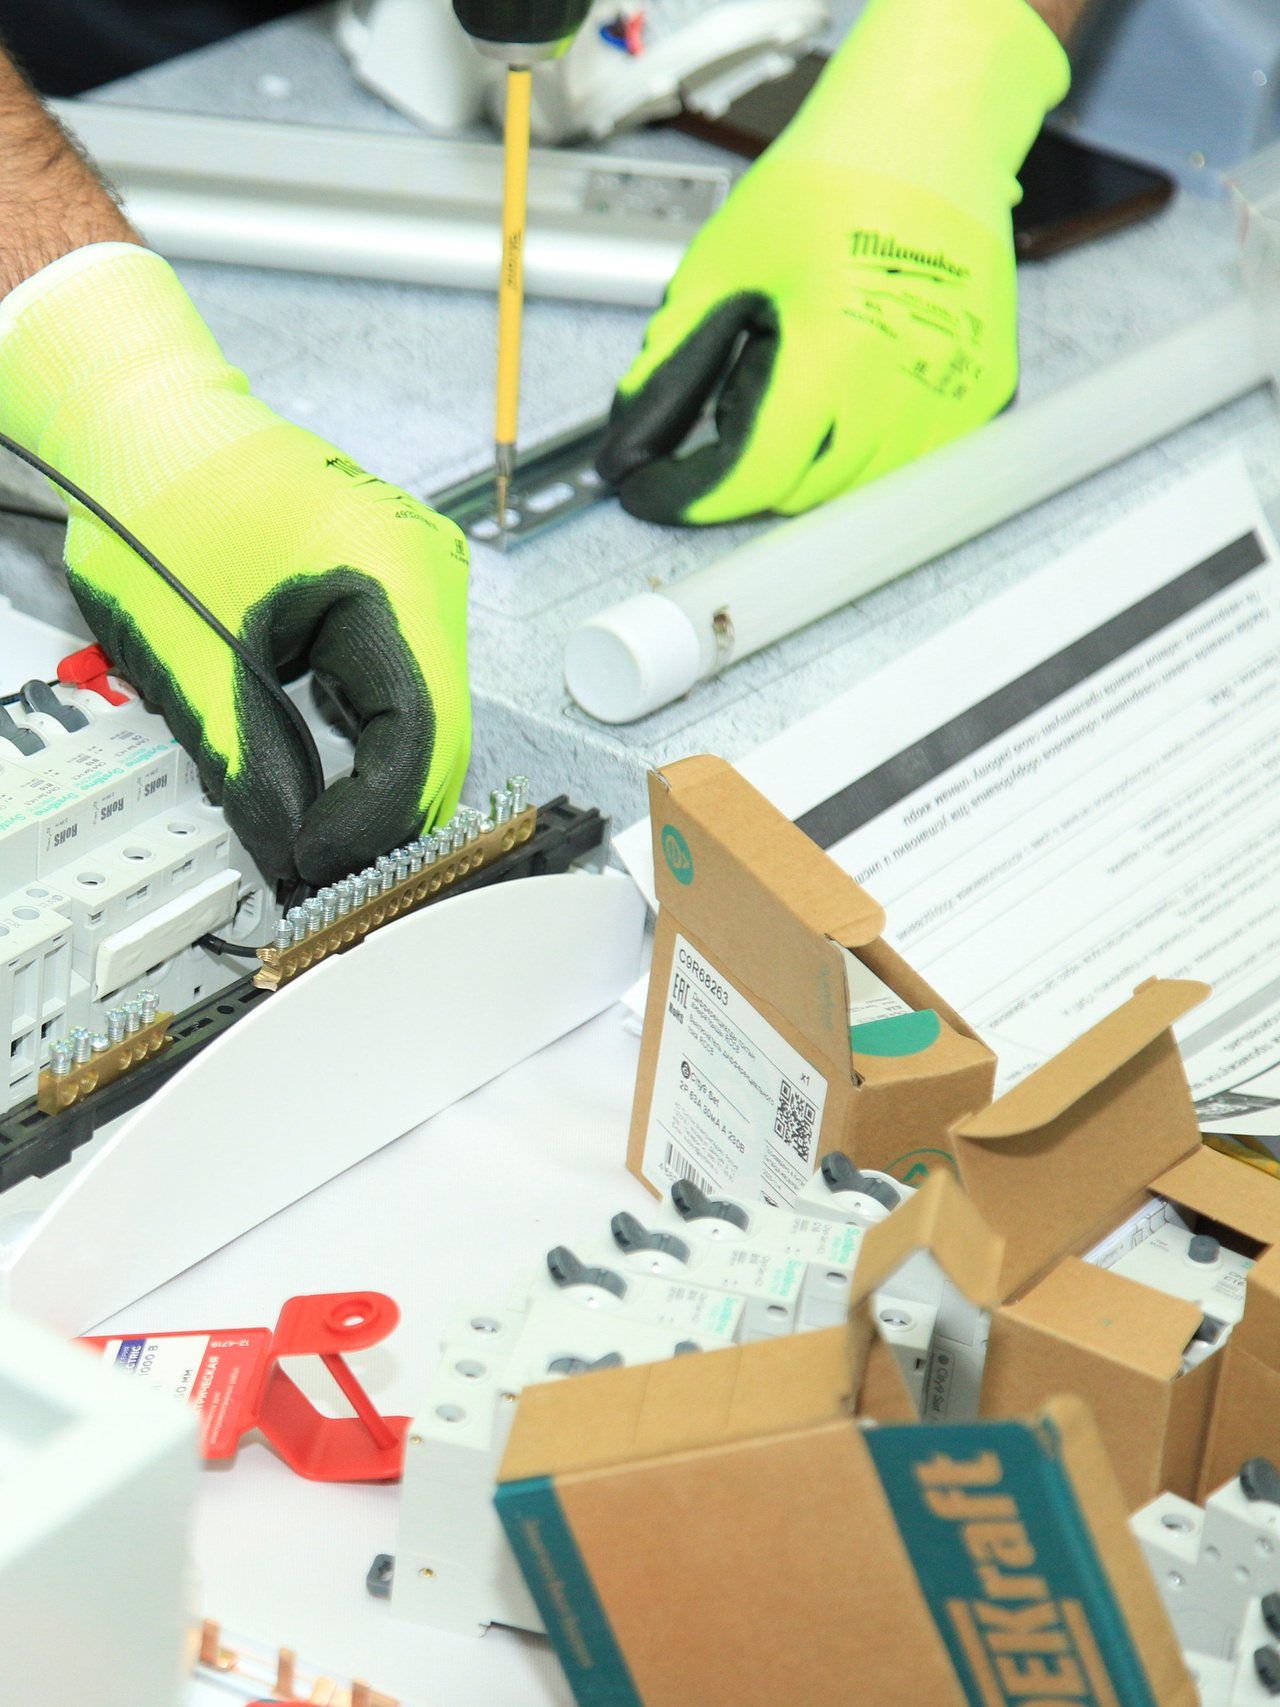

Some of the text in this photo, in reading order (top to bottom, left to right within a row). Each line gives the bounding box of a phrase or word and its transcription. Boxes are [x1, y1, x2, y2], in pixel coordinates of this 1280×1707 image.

[144, 774, 168, 798] RoHS
[100, 797, 124, 821] RoHS
[53, 823, 78, 847] RoHS
[672, 971, 690, 1010] EAC
[678, 945, 810, 1088] C9R68263 x1
[708, 1089, 719, 1108] Set
[125, 1345, 142, 1375] ECTRIC
[931, 1367, 948, 1412] City9 Set
